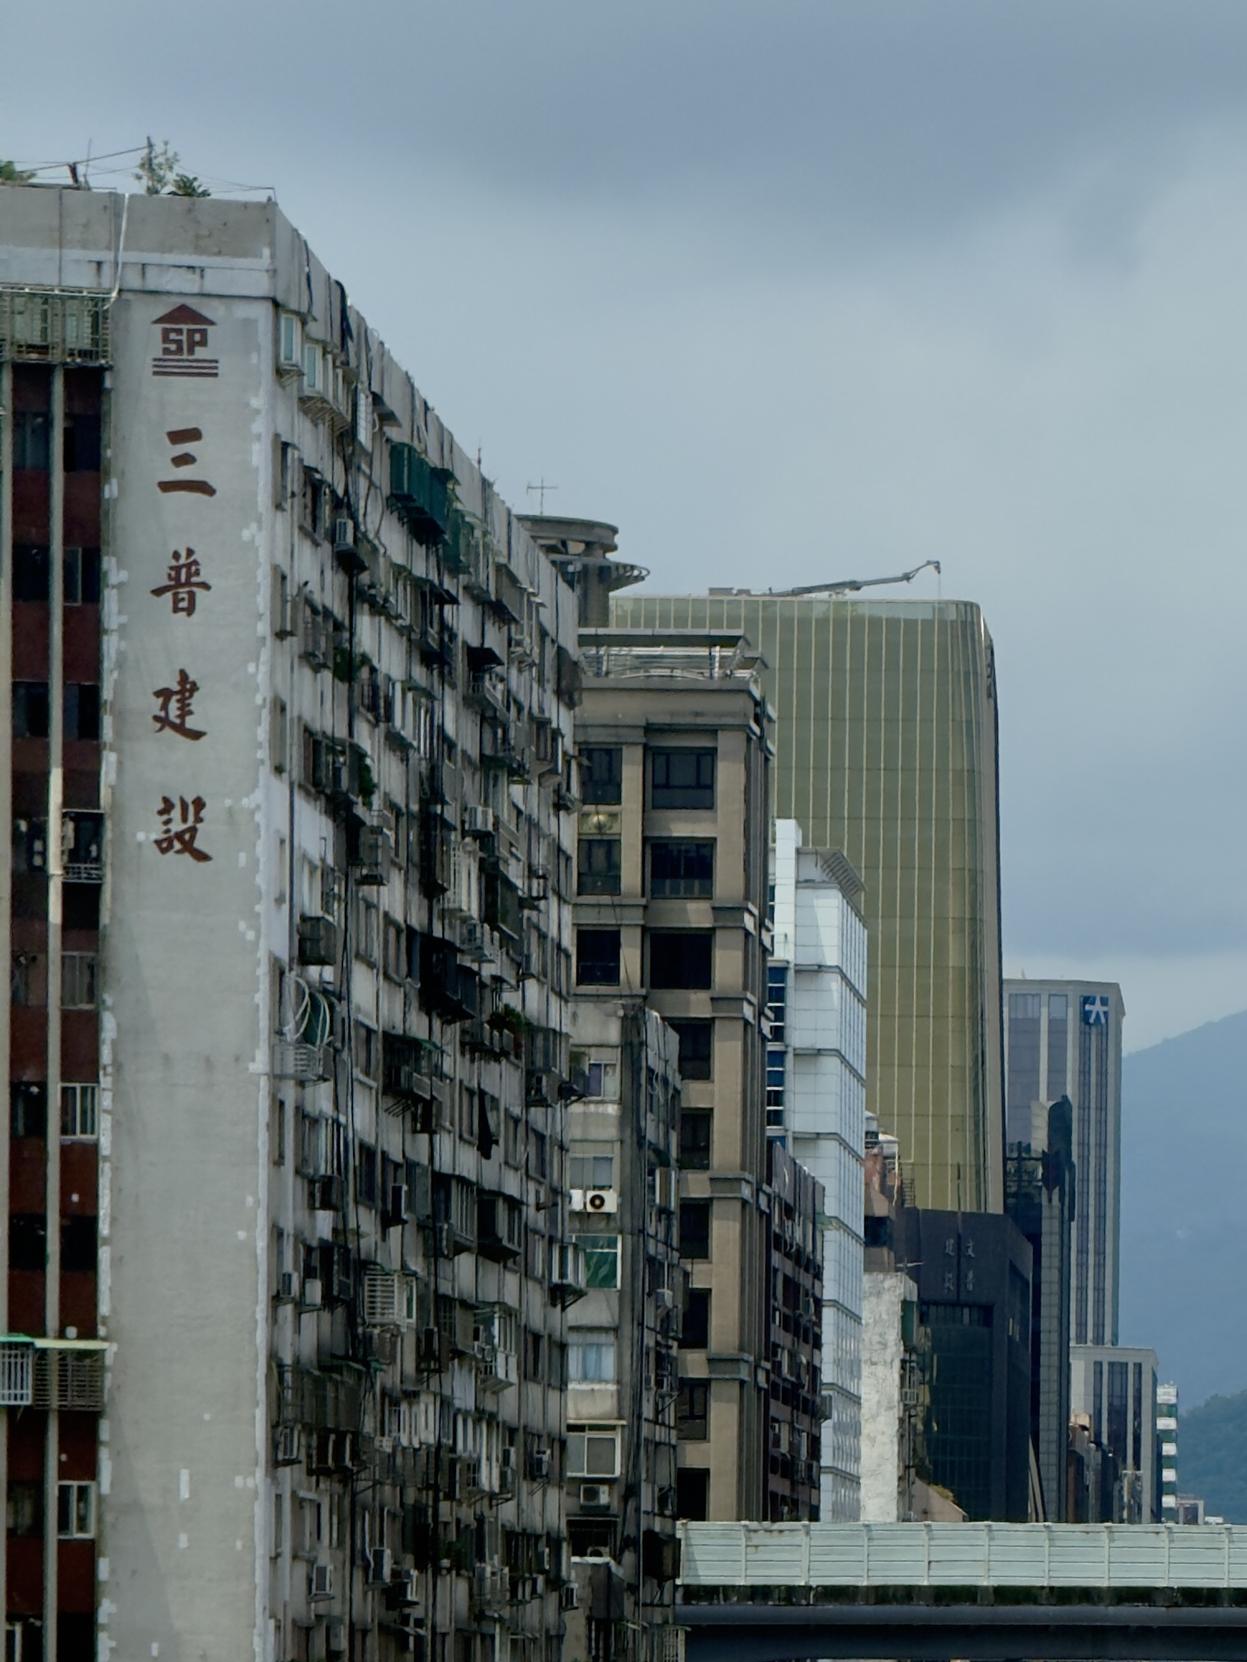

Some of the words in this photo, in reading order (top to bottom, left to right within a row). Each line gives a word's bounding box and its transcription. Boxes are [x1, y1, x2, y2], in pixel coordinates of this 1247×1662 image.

[161, 326, 208, 357] SP
[150, 426, 217, 864] 三普建設
